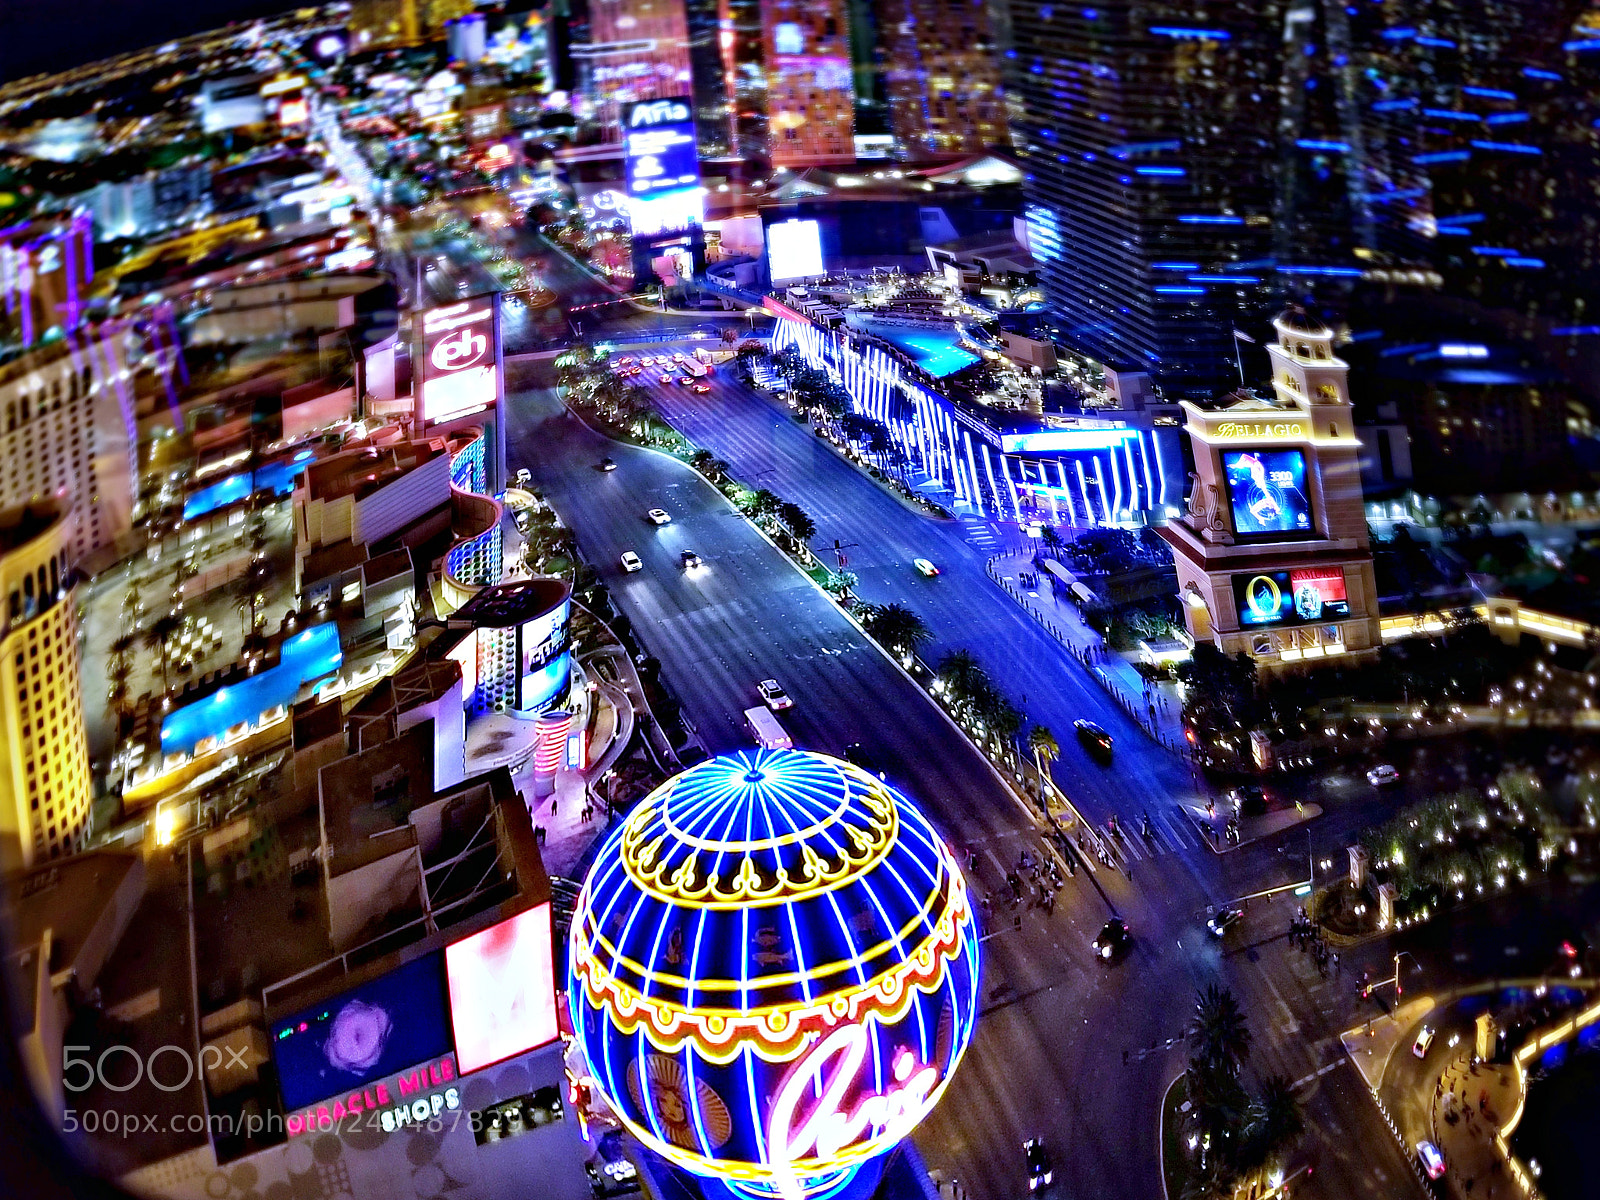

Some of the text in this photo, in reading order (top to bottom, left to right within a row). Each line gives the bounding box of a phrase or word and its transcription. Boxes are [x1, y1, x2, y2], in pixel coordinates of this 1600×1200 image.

[1213, 422, 1303, 438] BELLAGIO
[1269, 471, 1293, 482] 3300
[288, 1058, 454, 1137] MIRACLE MILE
[380, 1088, 460, 1132] SHOPS
